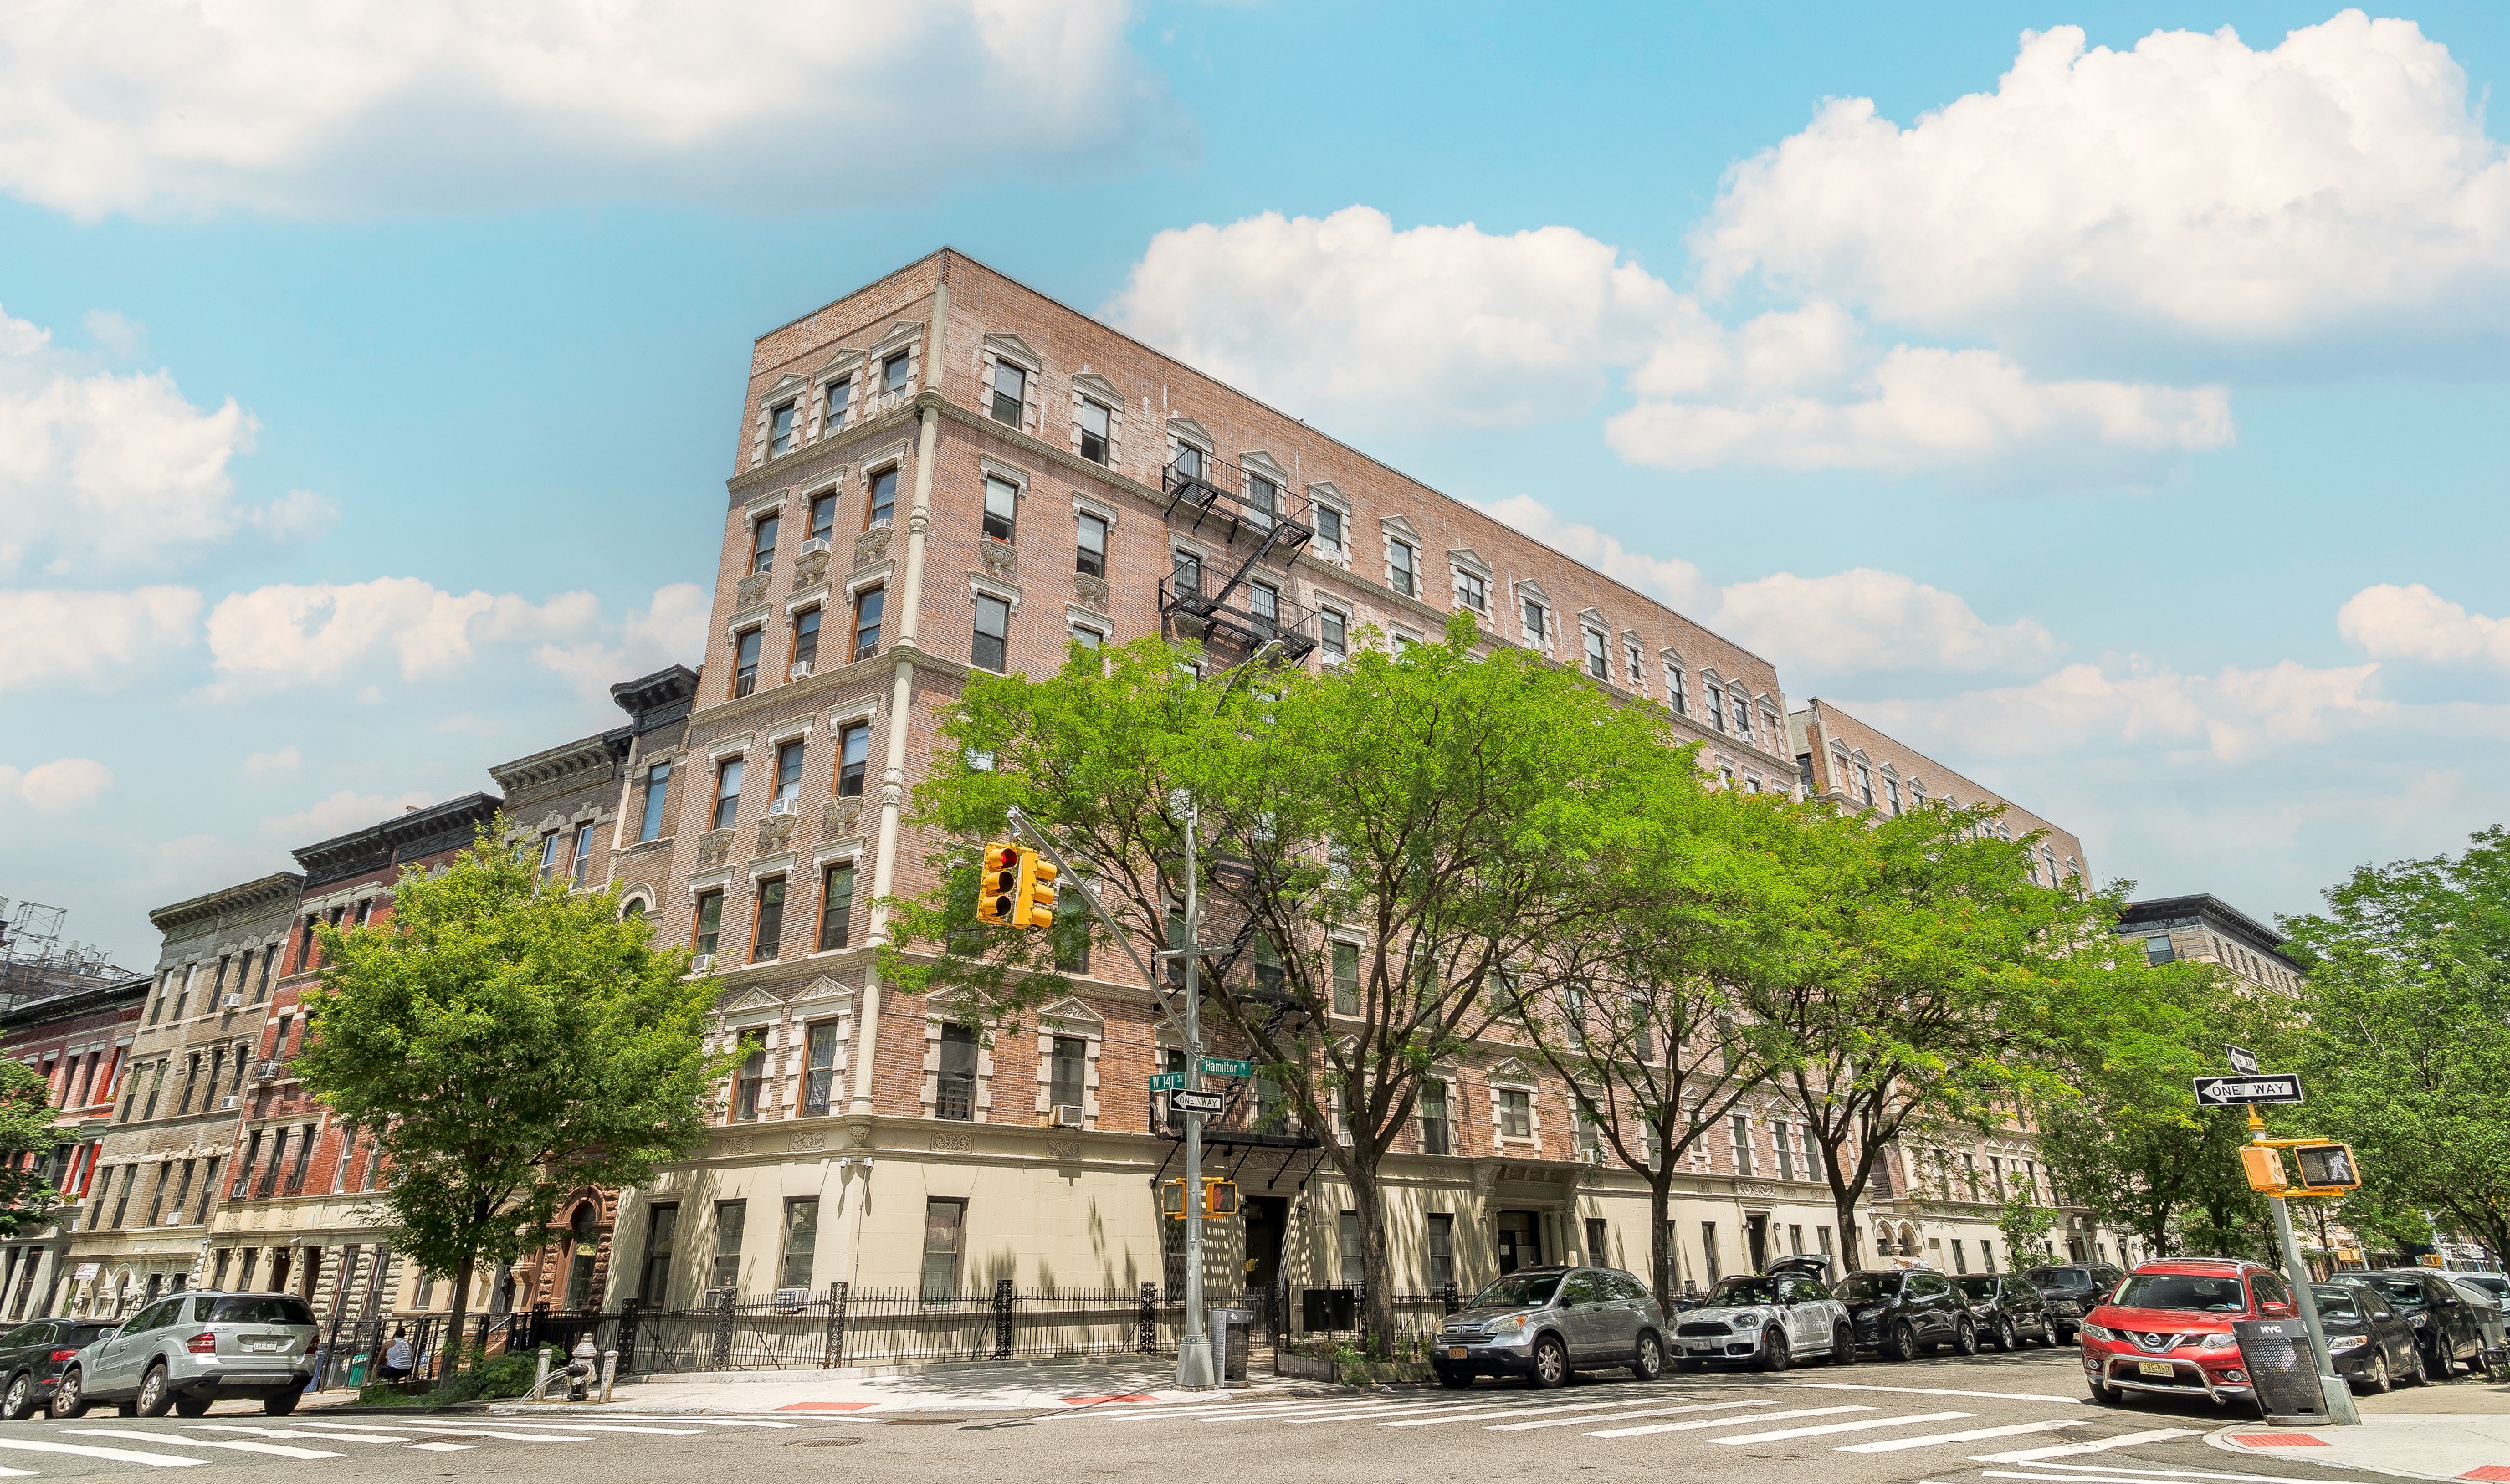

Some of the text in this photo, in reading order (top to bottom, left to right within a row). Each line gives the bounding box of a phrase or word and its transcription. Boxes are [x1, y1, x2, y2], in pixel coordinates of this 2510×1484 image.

[1206, 1059, 1238, 1074] Hamilton
[2233, 1054, 2255, 1070] ONE WAY
[1153, 1077, 1159, 1087] W
[1162, 1075, 1174, 1087] 141
[2212, 1083, 2284, 1097] ONE WAY
[1179, 1095, 1217, 1108] ONE WAY
[2259, 1325, 2282, 1333] NYC
